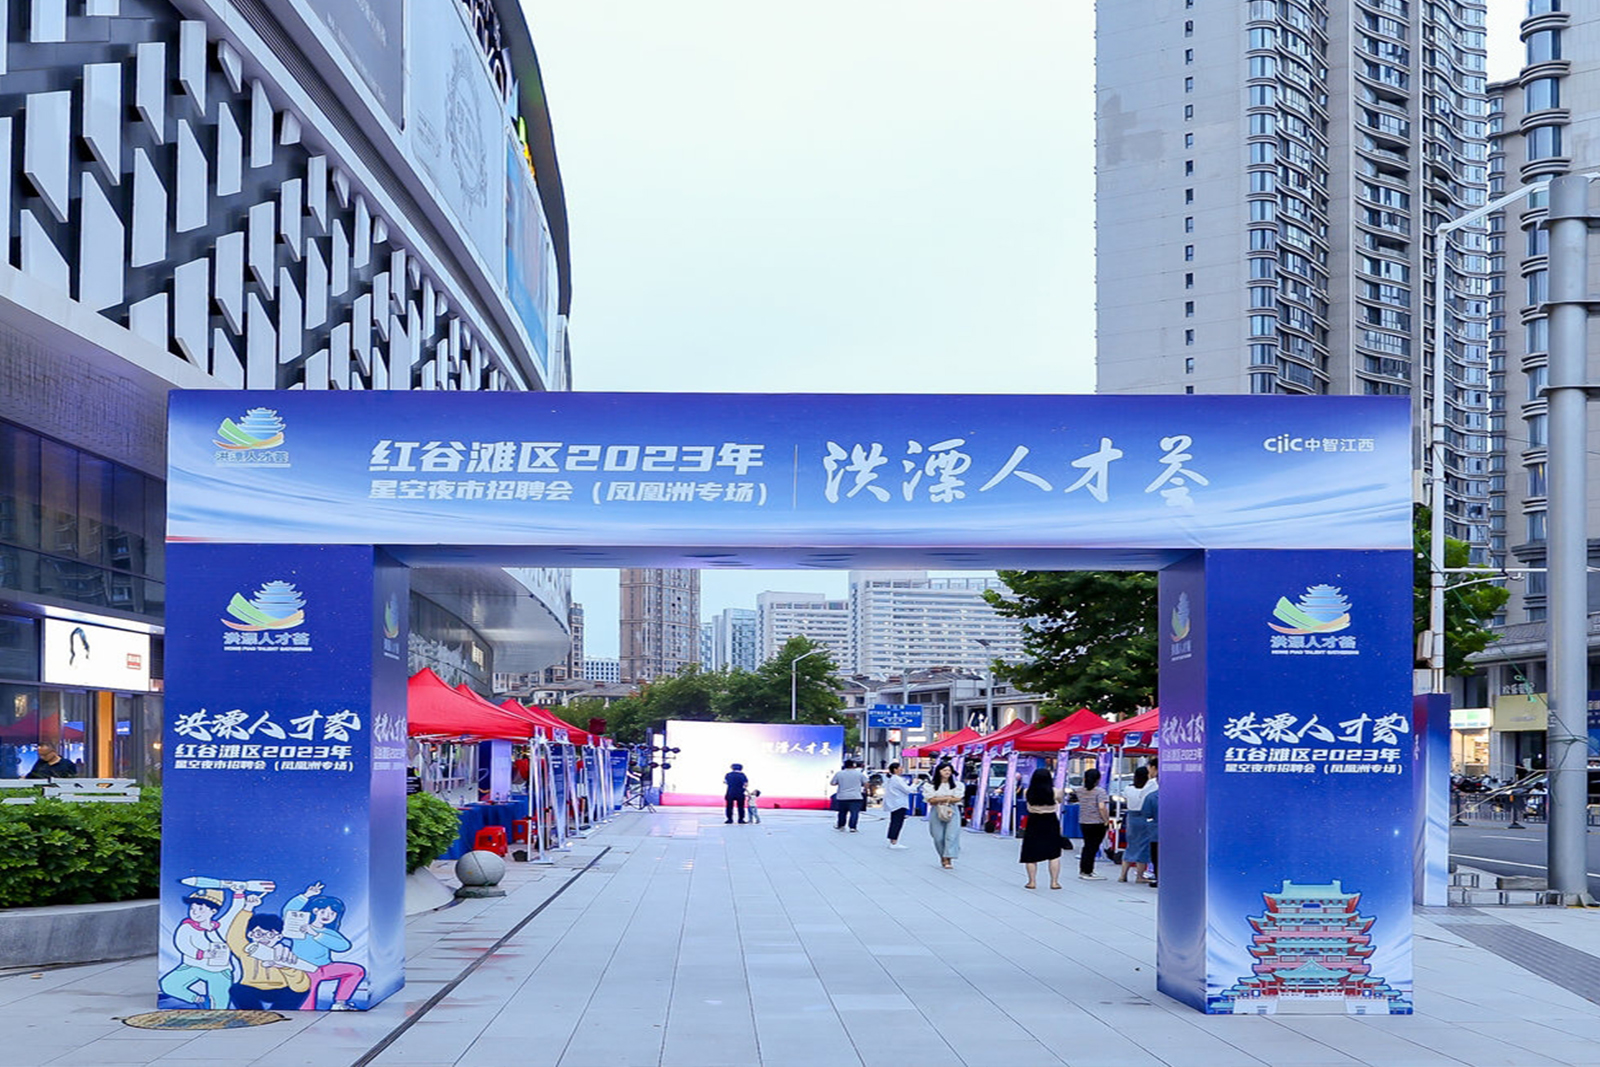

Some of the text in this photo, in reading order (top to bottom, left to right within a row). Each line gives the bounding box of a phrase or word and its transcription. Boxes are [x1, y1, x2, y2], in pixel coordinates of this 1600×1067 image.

[369, 440, 765, 475] 红谷滩区2023年
[823, 435, 1209, 507] 洪漂人才荟
[174, 744, 352, 759] 红谷滩区2023年
[1224, 747, 1401, 762] 红谷滩区2023年
